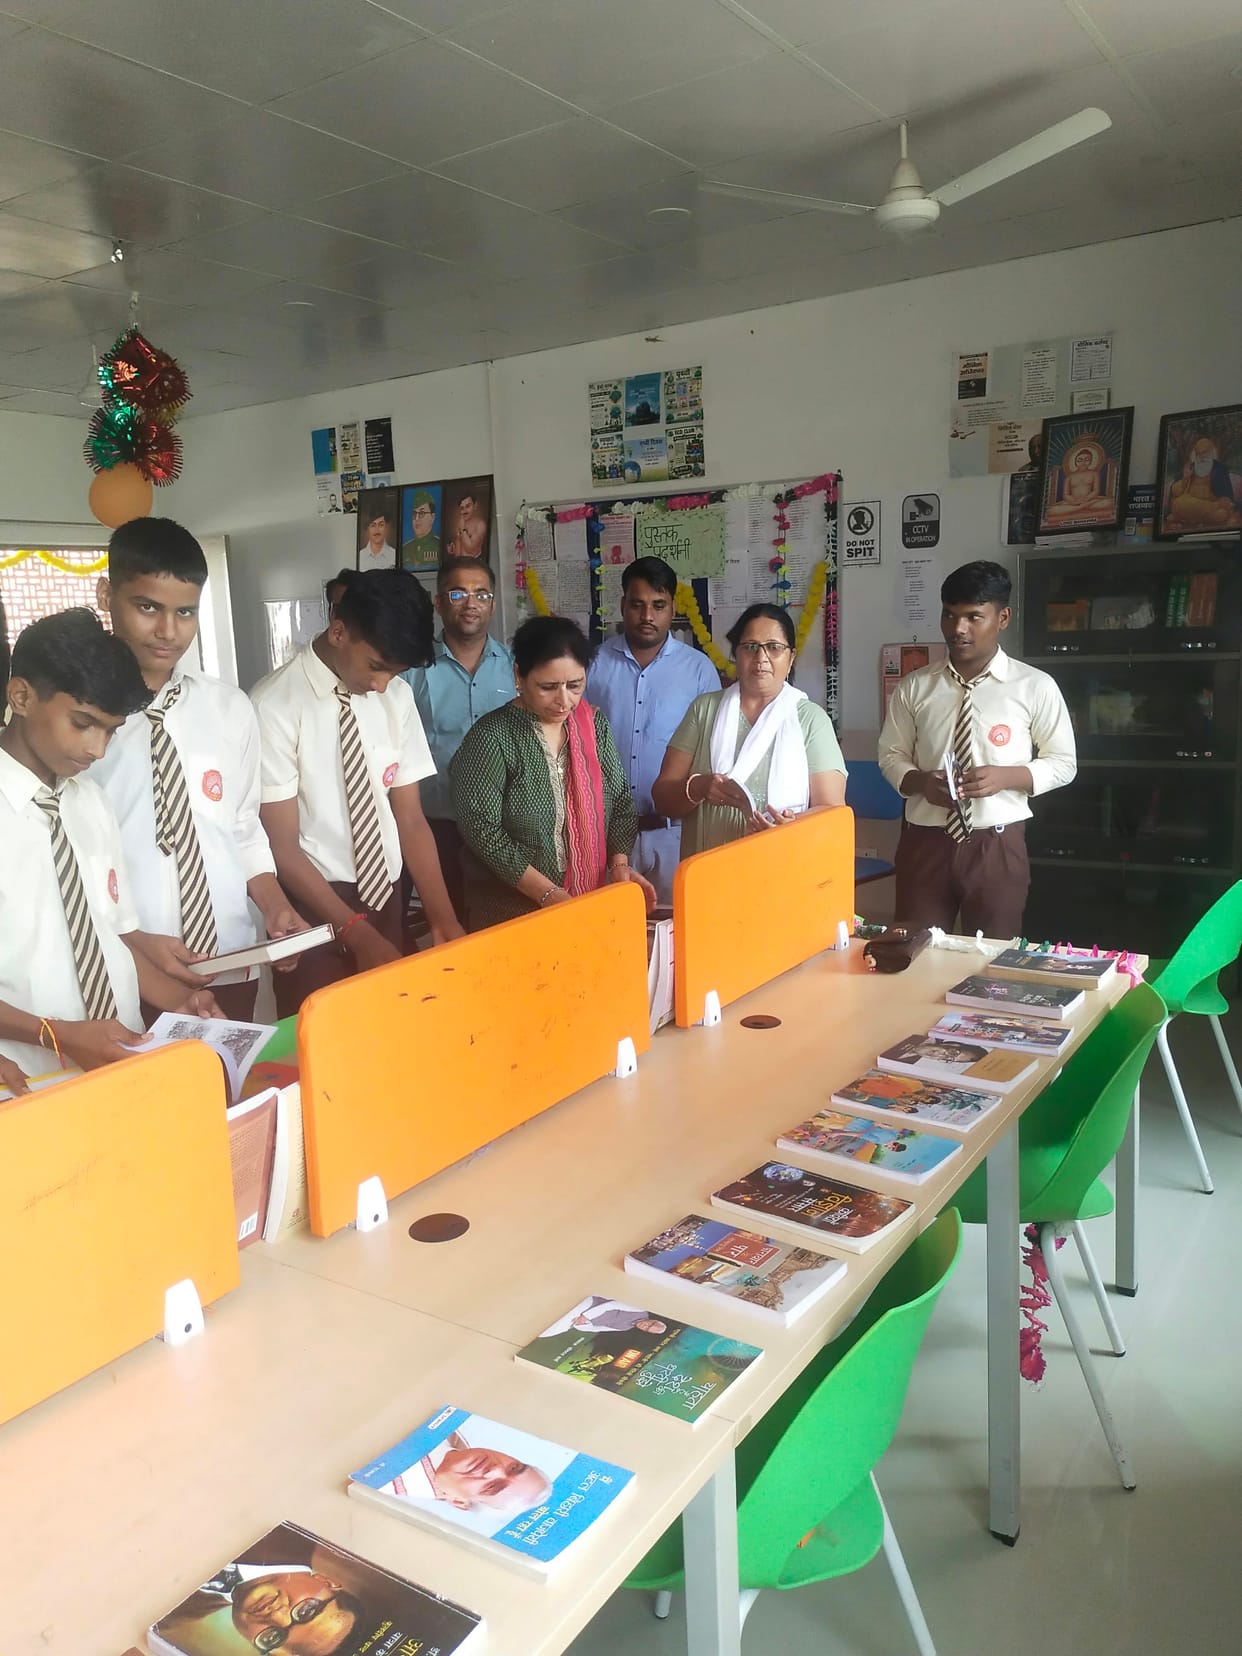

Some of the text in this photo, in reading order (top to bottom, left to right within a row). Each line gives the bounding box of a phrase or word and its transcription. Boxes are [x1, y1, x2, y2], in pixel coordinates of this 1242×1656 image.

[644, 524, 683, 548] पुस्तक
[911, 535, 936, 543] OPERATION
[912, 525, 929, 534] CCTV
[846, 547, 875, 558] SPIT
[801, 1192, 851, 1219] विज्ञान
[682, 1382, 716, 1409] चाहता
[522, 1470, 600, 1545] अटल बिहारी वाजपेयी
